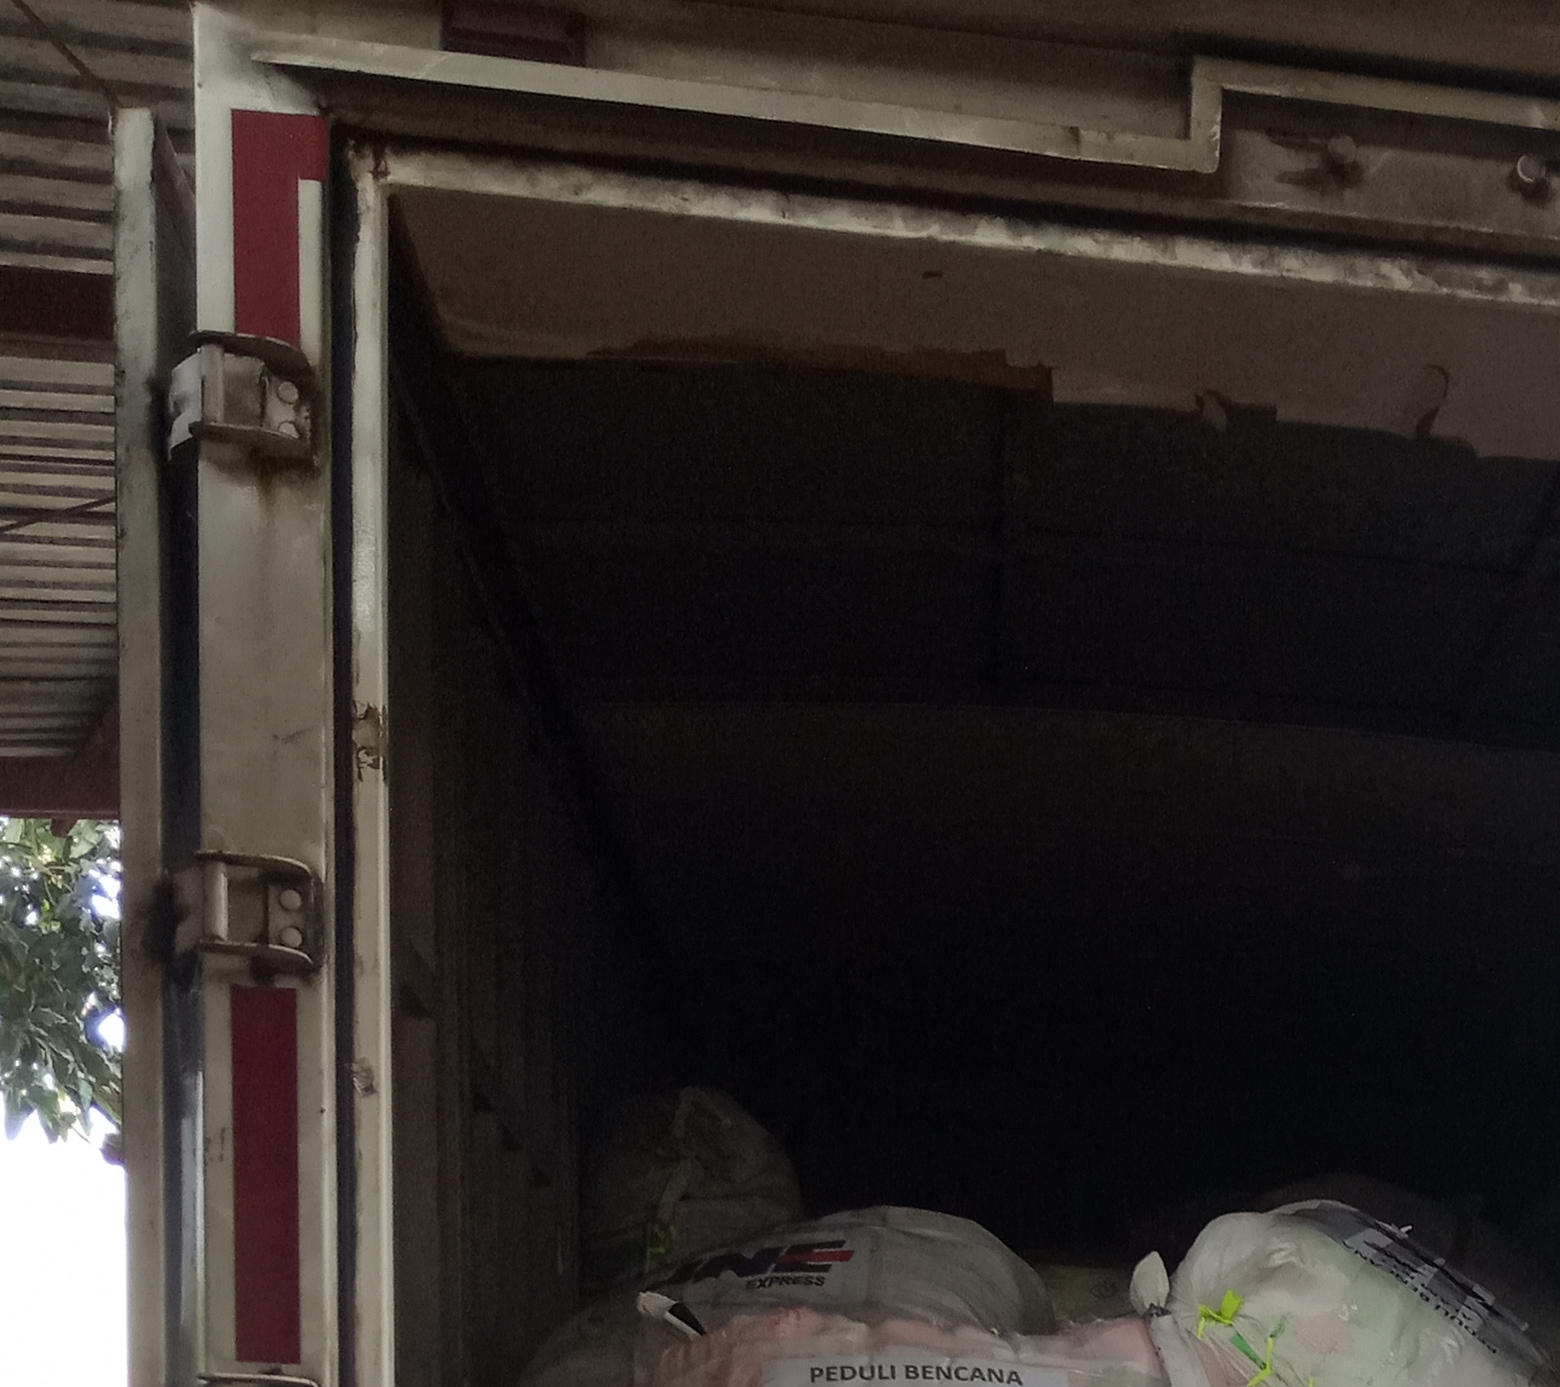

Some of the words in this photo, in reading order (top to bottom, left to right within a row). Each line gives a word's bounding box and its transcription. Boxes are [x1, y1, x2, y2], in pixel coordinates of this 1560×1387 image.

[745, 1275, 826, 1290] EXPRESS
[809, 1364, 897, 1384] PEDULI
[904, 1364, 1024, 1387] BENCANA
